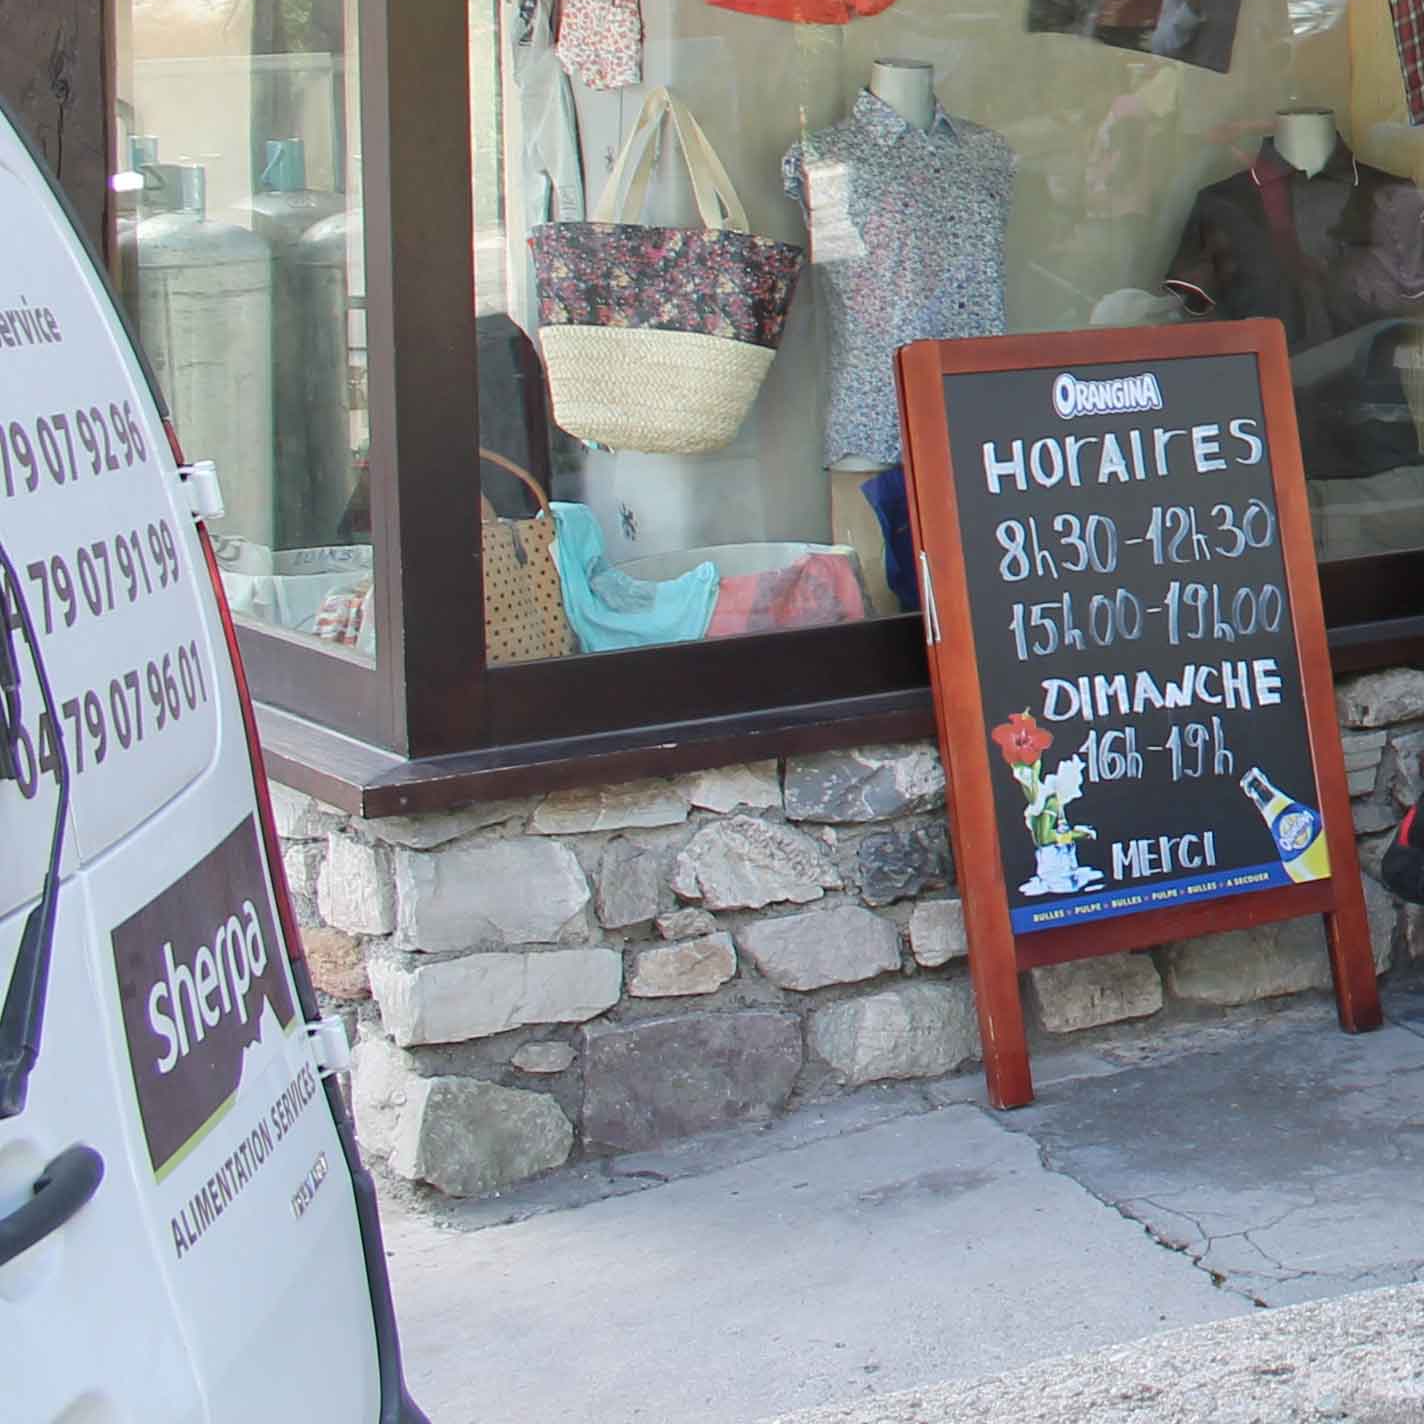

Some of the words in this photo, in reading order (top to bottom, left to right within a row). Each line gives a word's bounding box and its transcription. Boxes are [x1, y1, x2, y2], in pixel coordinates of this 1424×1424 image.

[36, 413, 79, 486] 07
[76, 406, 120, 476] 92
[109, 399, 147, 468] 96
[1053, 372, 1164, 419] ORANGINA
[26, 554, 78, 635] 79
[77, 540, 116, 617] 07
[115, 529, 153, 603] 91
[148, 518, 180, 590] 99
[62, 688, 108, 775] 79
[110, 669, 144, 751] 07
[146, 652, 181, 732] 96
[178, 639, 208, 712] 01
[1040, 657, 1283, 722] DIMANCHE
[148, 899, 269, 1075] sherpa
[169, 1113, 274, 1260] ALIMENTATION
[270, 1061, 317, 1142] SERVICES
